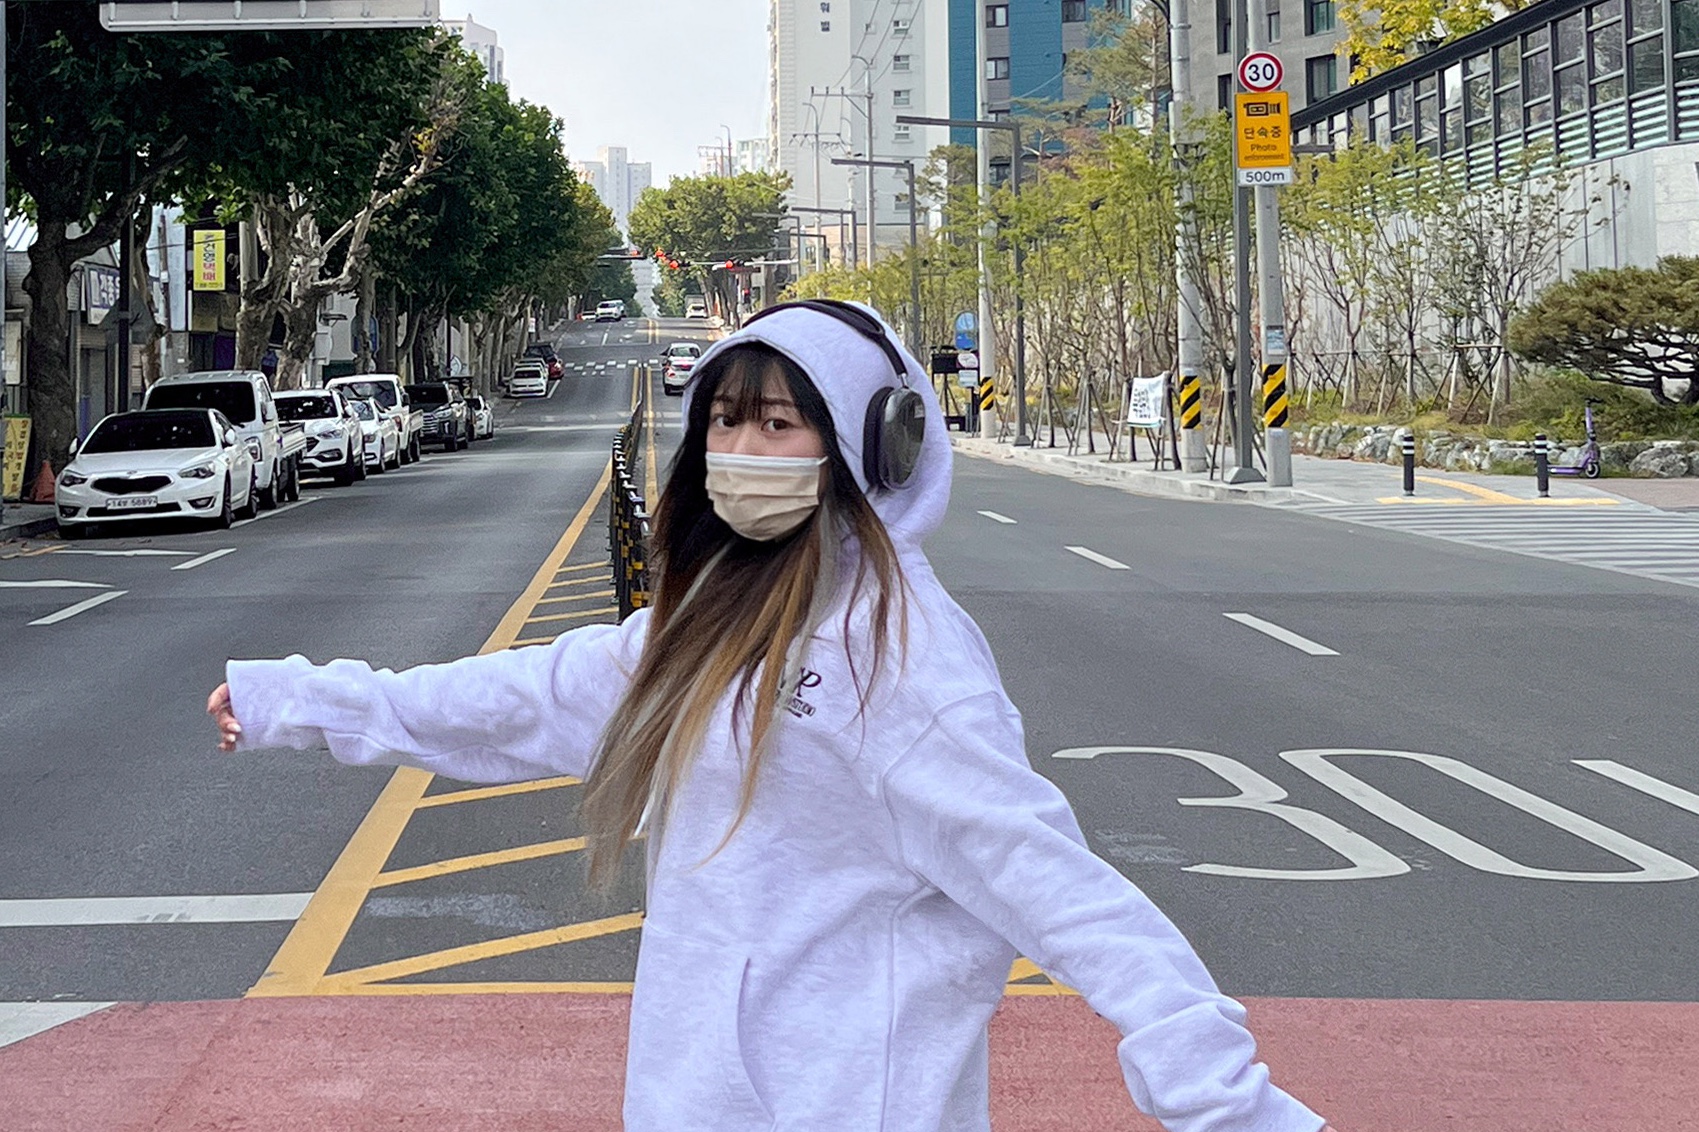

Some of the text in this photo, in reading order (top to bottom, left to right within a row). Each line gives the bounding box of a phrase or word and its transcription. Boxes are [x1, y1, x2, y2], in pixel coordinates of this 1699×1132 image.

[1248, 63, 1275, 81] 30
[1244, 126, 1281, 140] 단속중
[1250, 144, 1277, 152] Photo
[1246, 171, 1285, 182] 500m
[1051, 746, 1699, 882] 30
